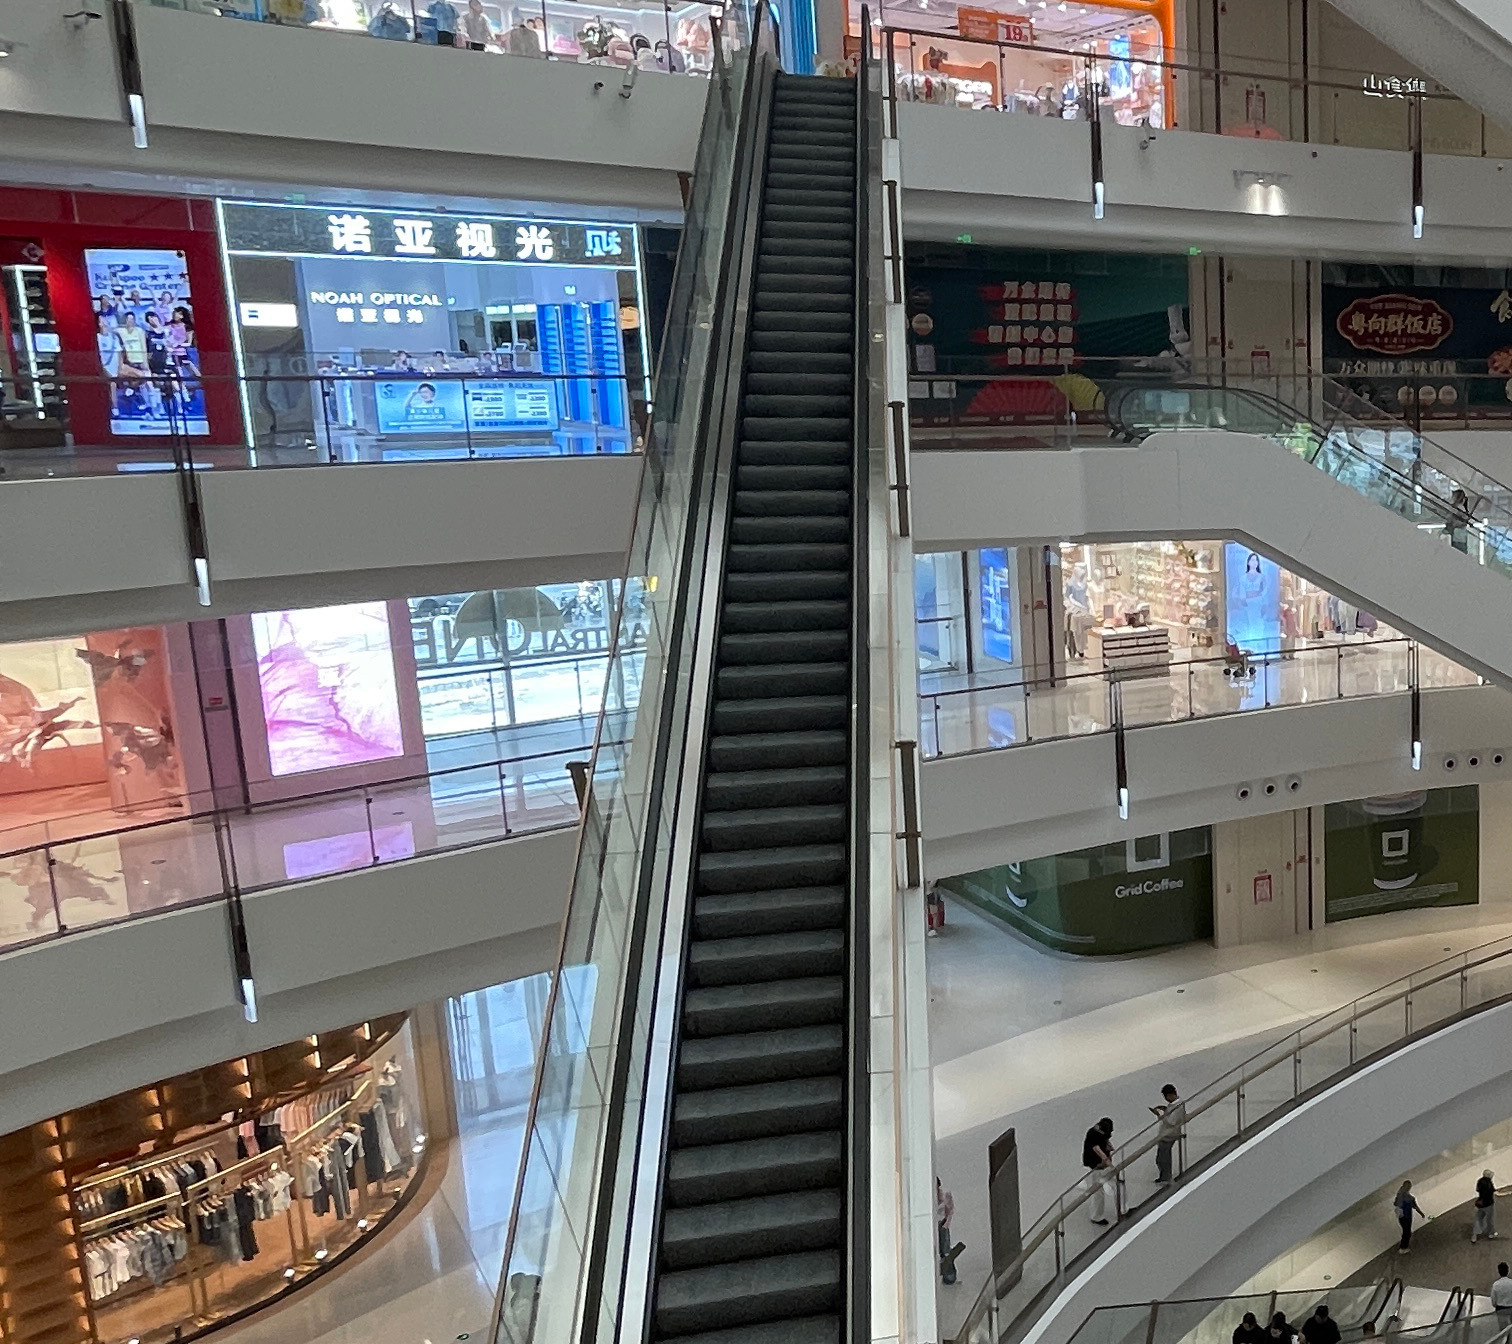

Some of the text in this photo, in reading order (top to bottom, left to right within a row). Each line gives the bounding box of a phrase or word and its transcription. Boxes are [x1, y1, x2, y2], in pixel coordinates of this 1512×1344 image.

[328, 214, 555, 261] 诺亚视光
[310, 290, 442, 307] NOAH OPTICAL
[1115, 878, 1184, 898] Grid Coffee
